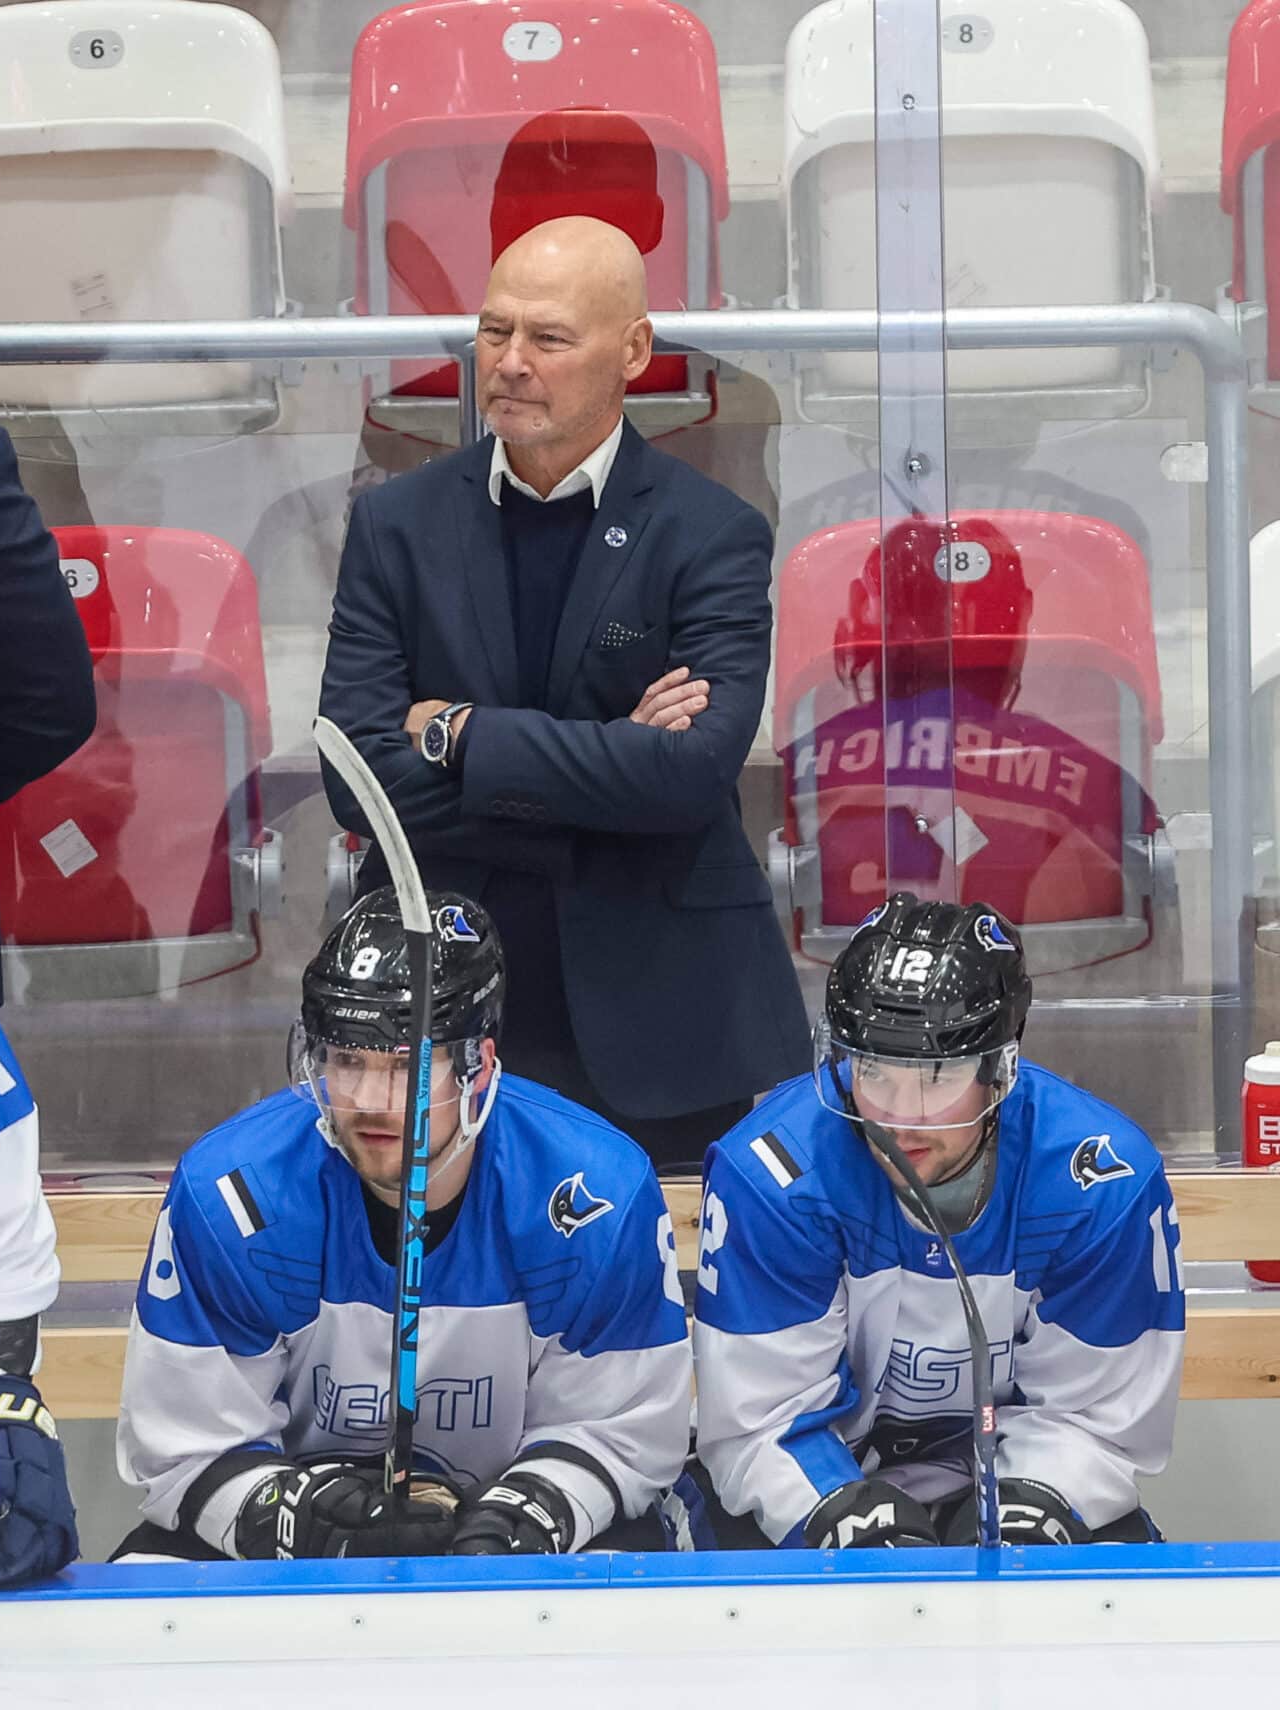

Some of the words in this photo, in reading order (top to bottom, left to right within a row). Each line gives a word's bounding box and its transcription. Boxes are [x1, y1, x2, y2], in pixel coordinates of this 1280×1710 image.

[524, 30, 539, 50] 7
[959, 23, 974, 44] 8
[90, 39, 105, 60] 6
[954, 551, 970, 572] 8
[64, 569, 78, 589] 6
[349, 947, 381, 981] 8
[889, 947, 933, 983] 12
[334, 1007, 381, 1020] AUER
